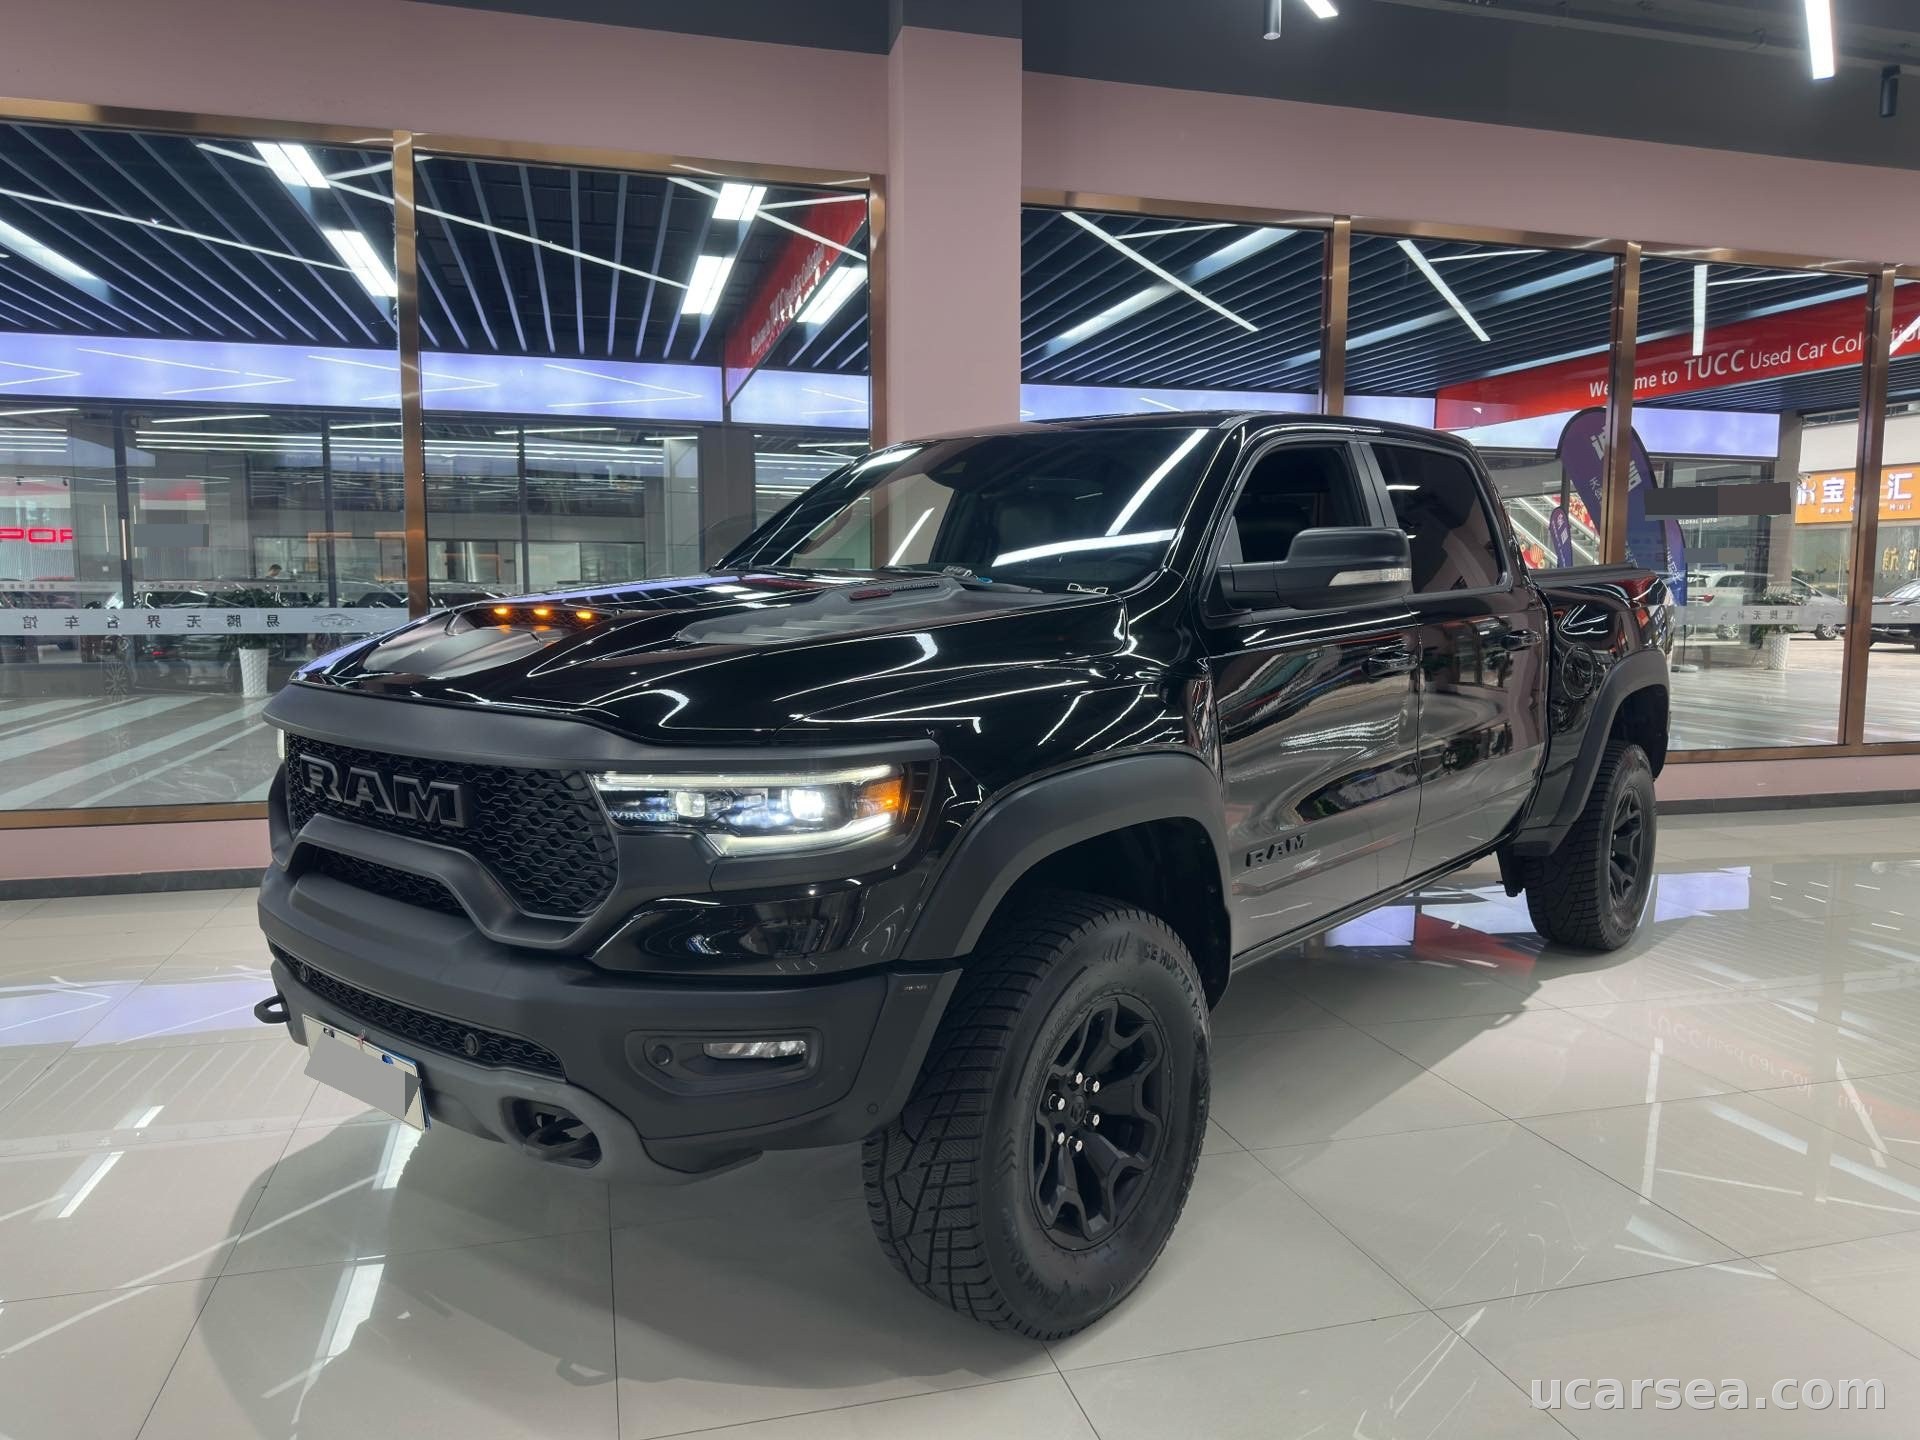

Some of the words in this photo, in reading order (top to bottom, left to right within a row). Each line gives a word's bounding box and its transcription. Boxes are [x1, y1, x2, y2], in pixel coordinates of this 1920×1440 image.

[1589, 376, 1657, 398] Weme
[1661, 370, 1678, 386] to
[1684, 349, 1745, 381] TUCC
[1749, 345, 1791, 370] Used
[1796, 342, 1827, 361] Car
[300, 753, 465, 828] RAM
[1246, 832, 1306, 867] RAM
